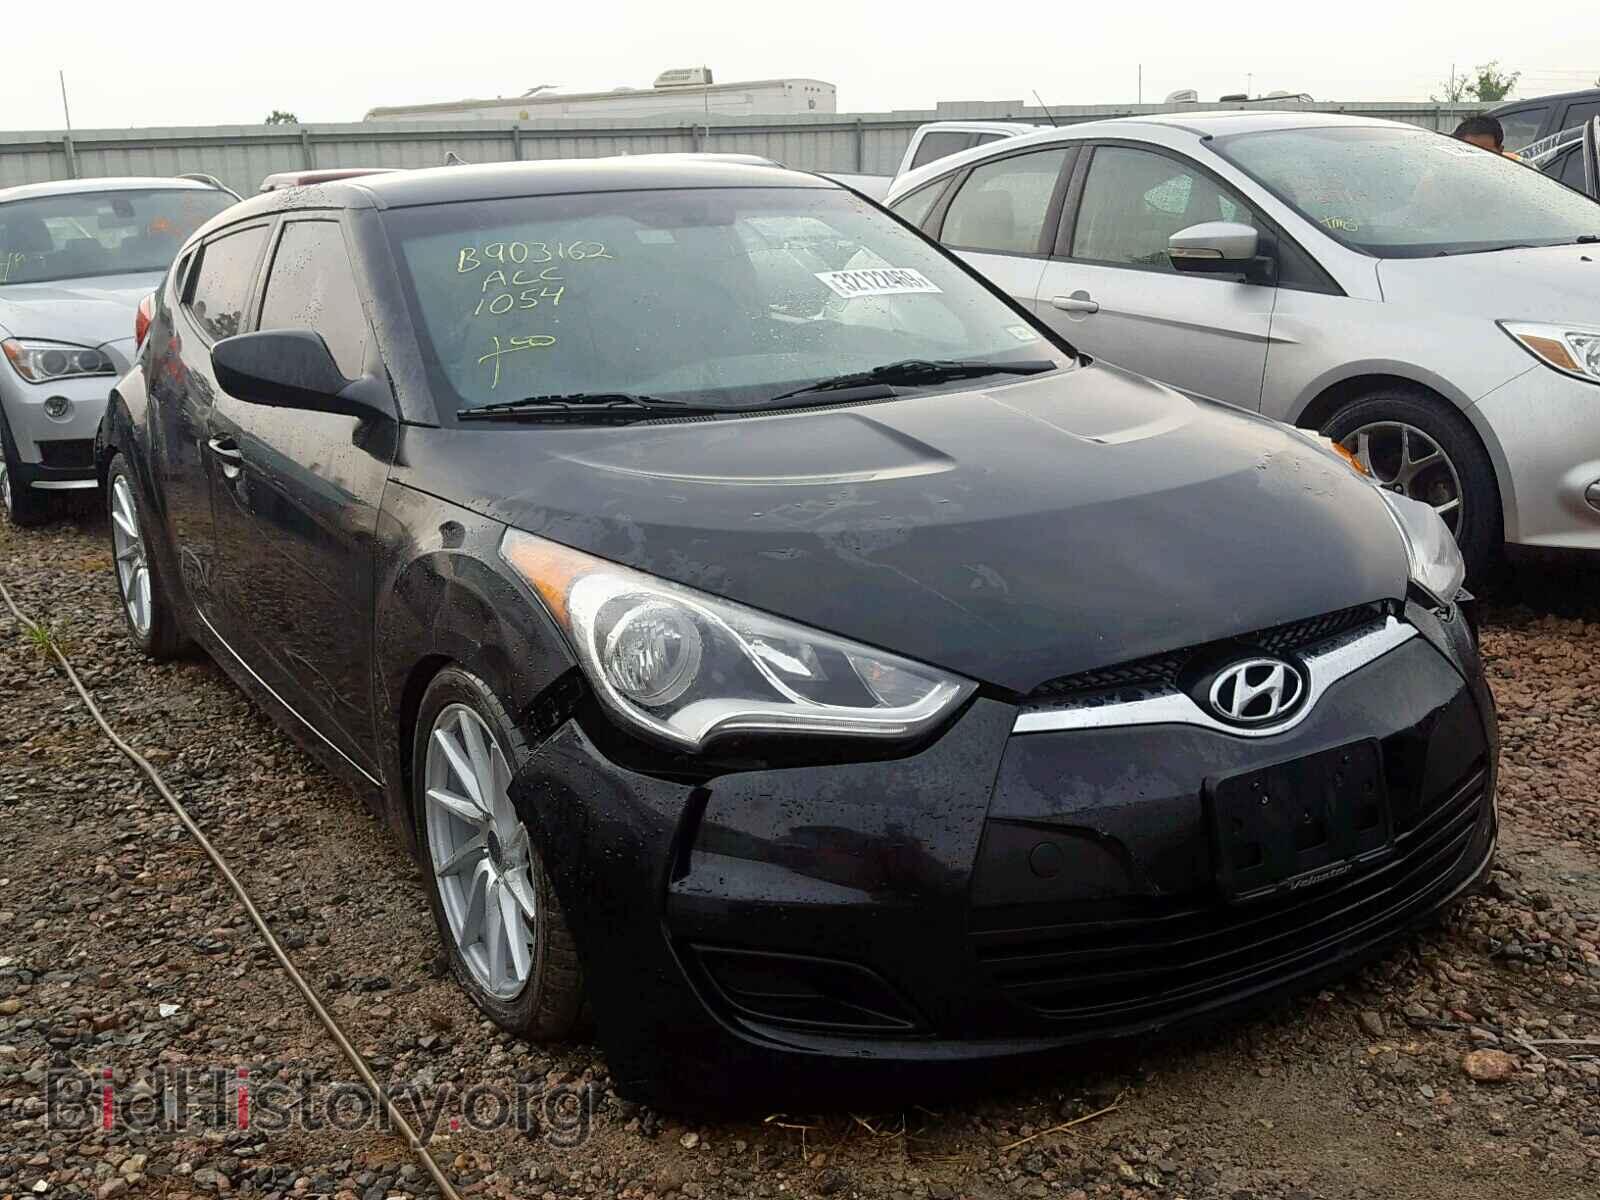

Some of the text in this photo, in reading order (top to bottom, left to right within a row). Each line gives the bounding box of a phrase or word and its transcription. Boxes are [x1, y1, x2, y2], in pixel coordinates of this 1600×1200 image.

[457, 241, 613, 272] B903162
[482, 267, 564, 292] ACC
[474, 286, 565, 315] 1054
